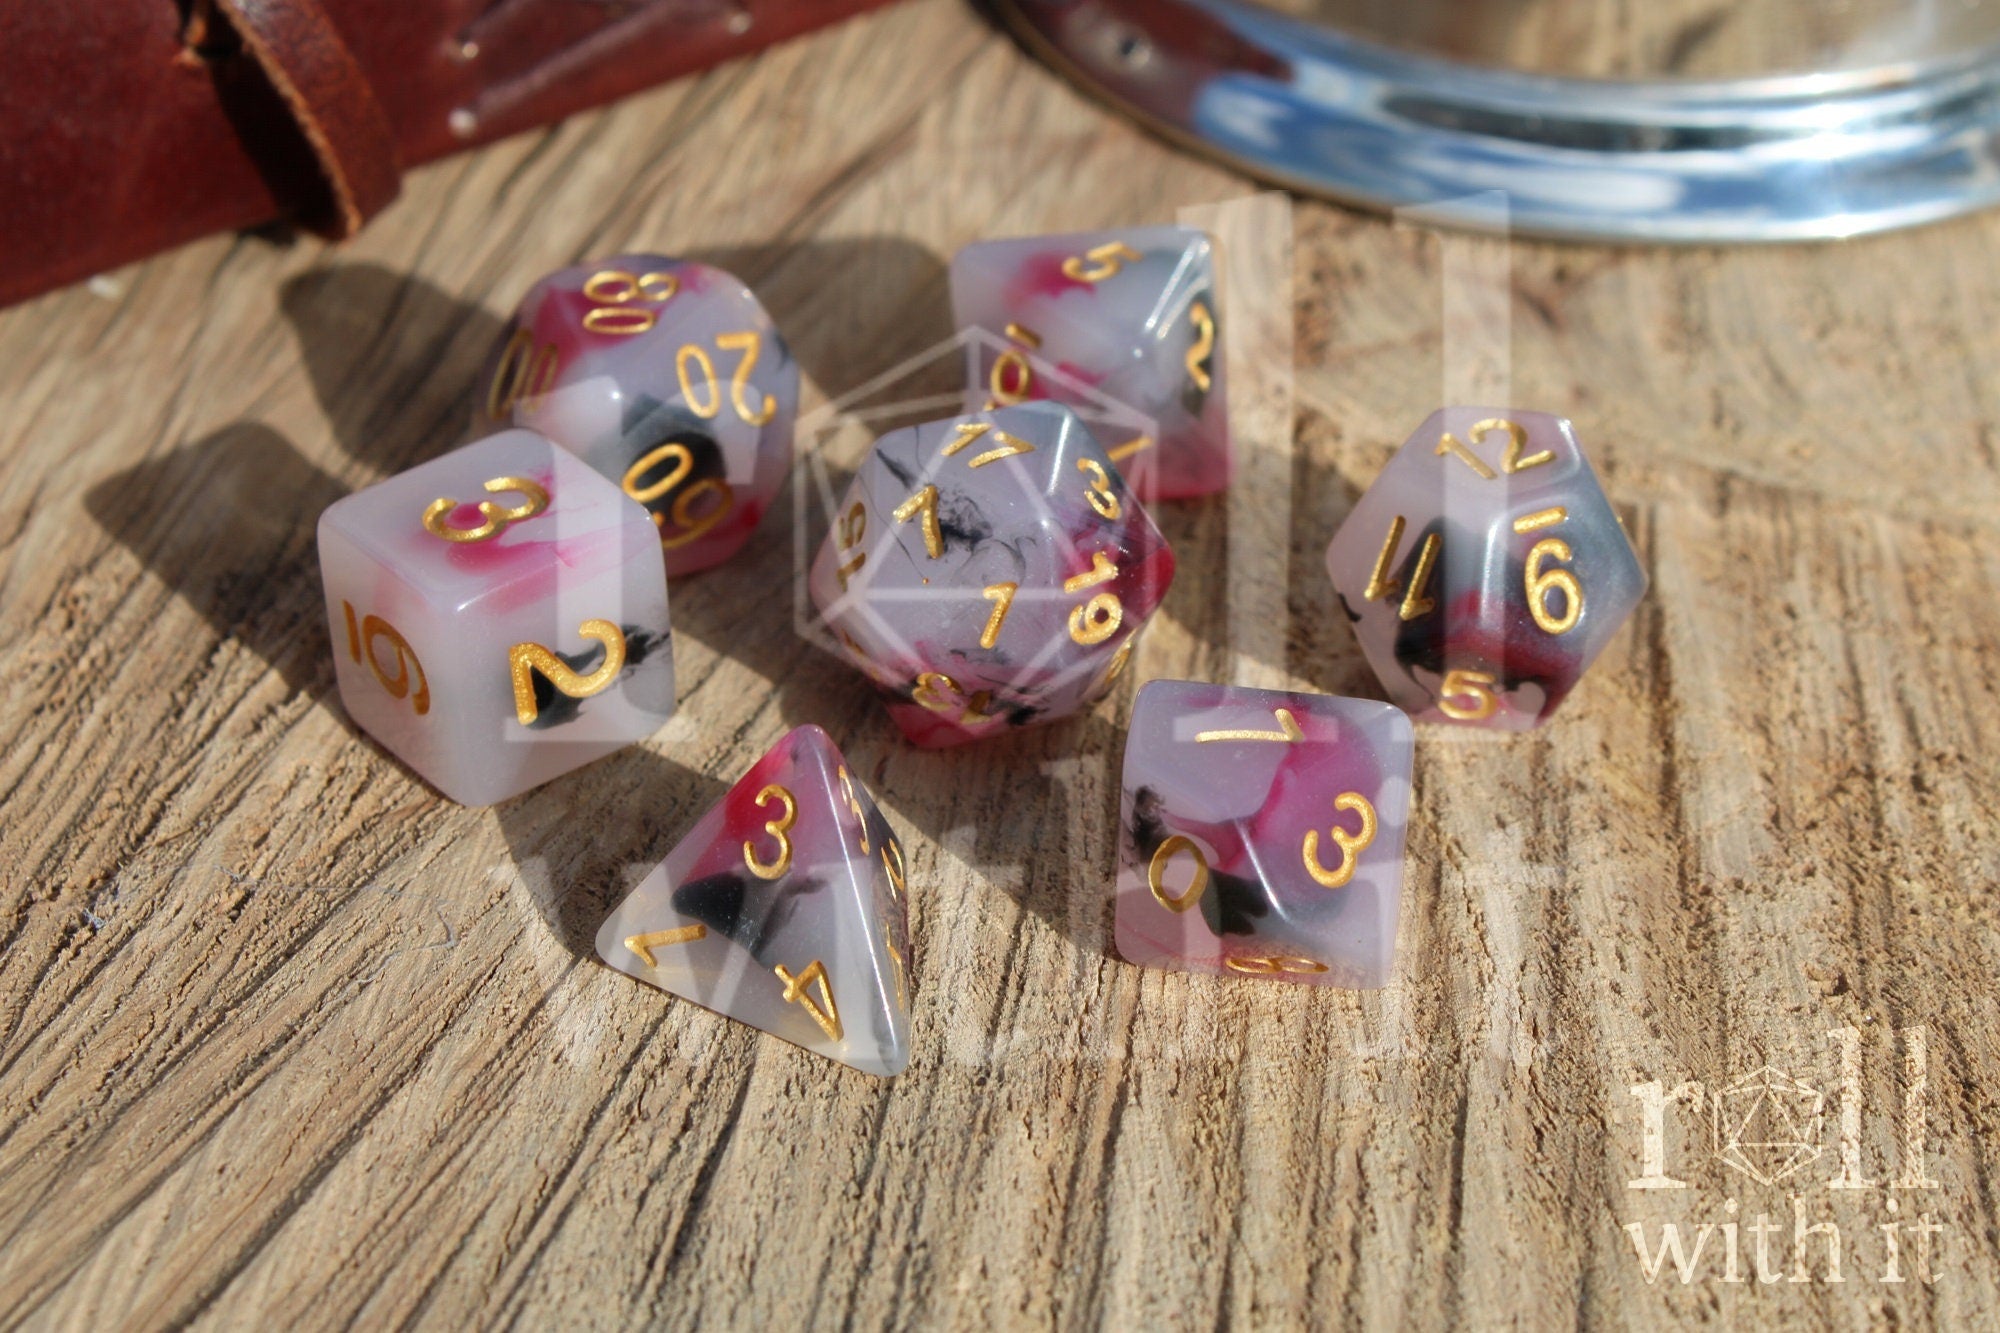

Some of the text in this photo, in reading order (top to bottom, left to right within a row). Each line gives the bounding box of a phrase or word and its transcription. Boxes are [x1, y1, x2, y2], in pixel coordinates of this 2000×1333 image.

[1062, 241, 1143, 283] 5
[676, 331, 777, 426] 20
[1186, 302, 1214, 391] 2
[1077, 457, 1121, 520] 3
[1434, 418, 1557, 480] 12
[422, 477, 549, 543] 3
[509, 618, 626, 726] 2
[1438, 670, 1498, 720] 5
[744, 784, 799, 880] 3
[1303, 792, 1378, 888] 3
[775, 960, 845, 1042] 4
